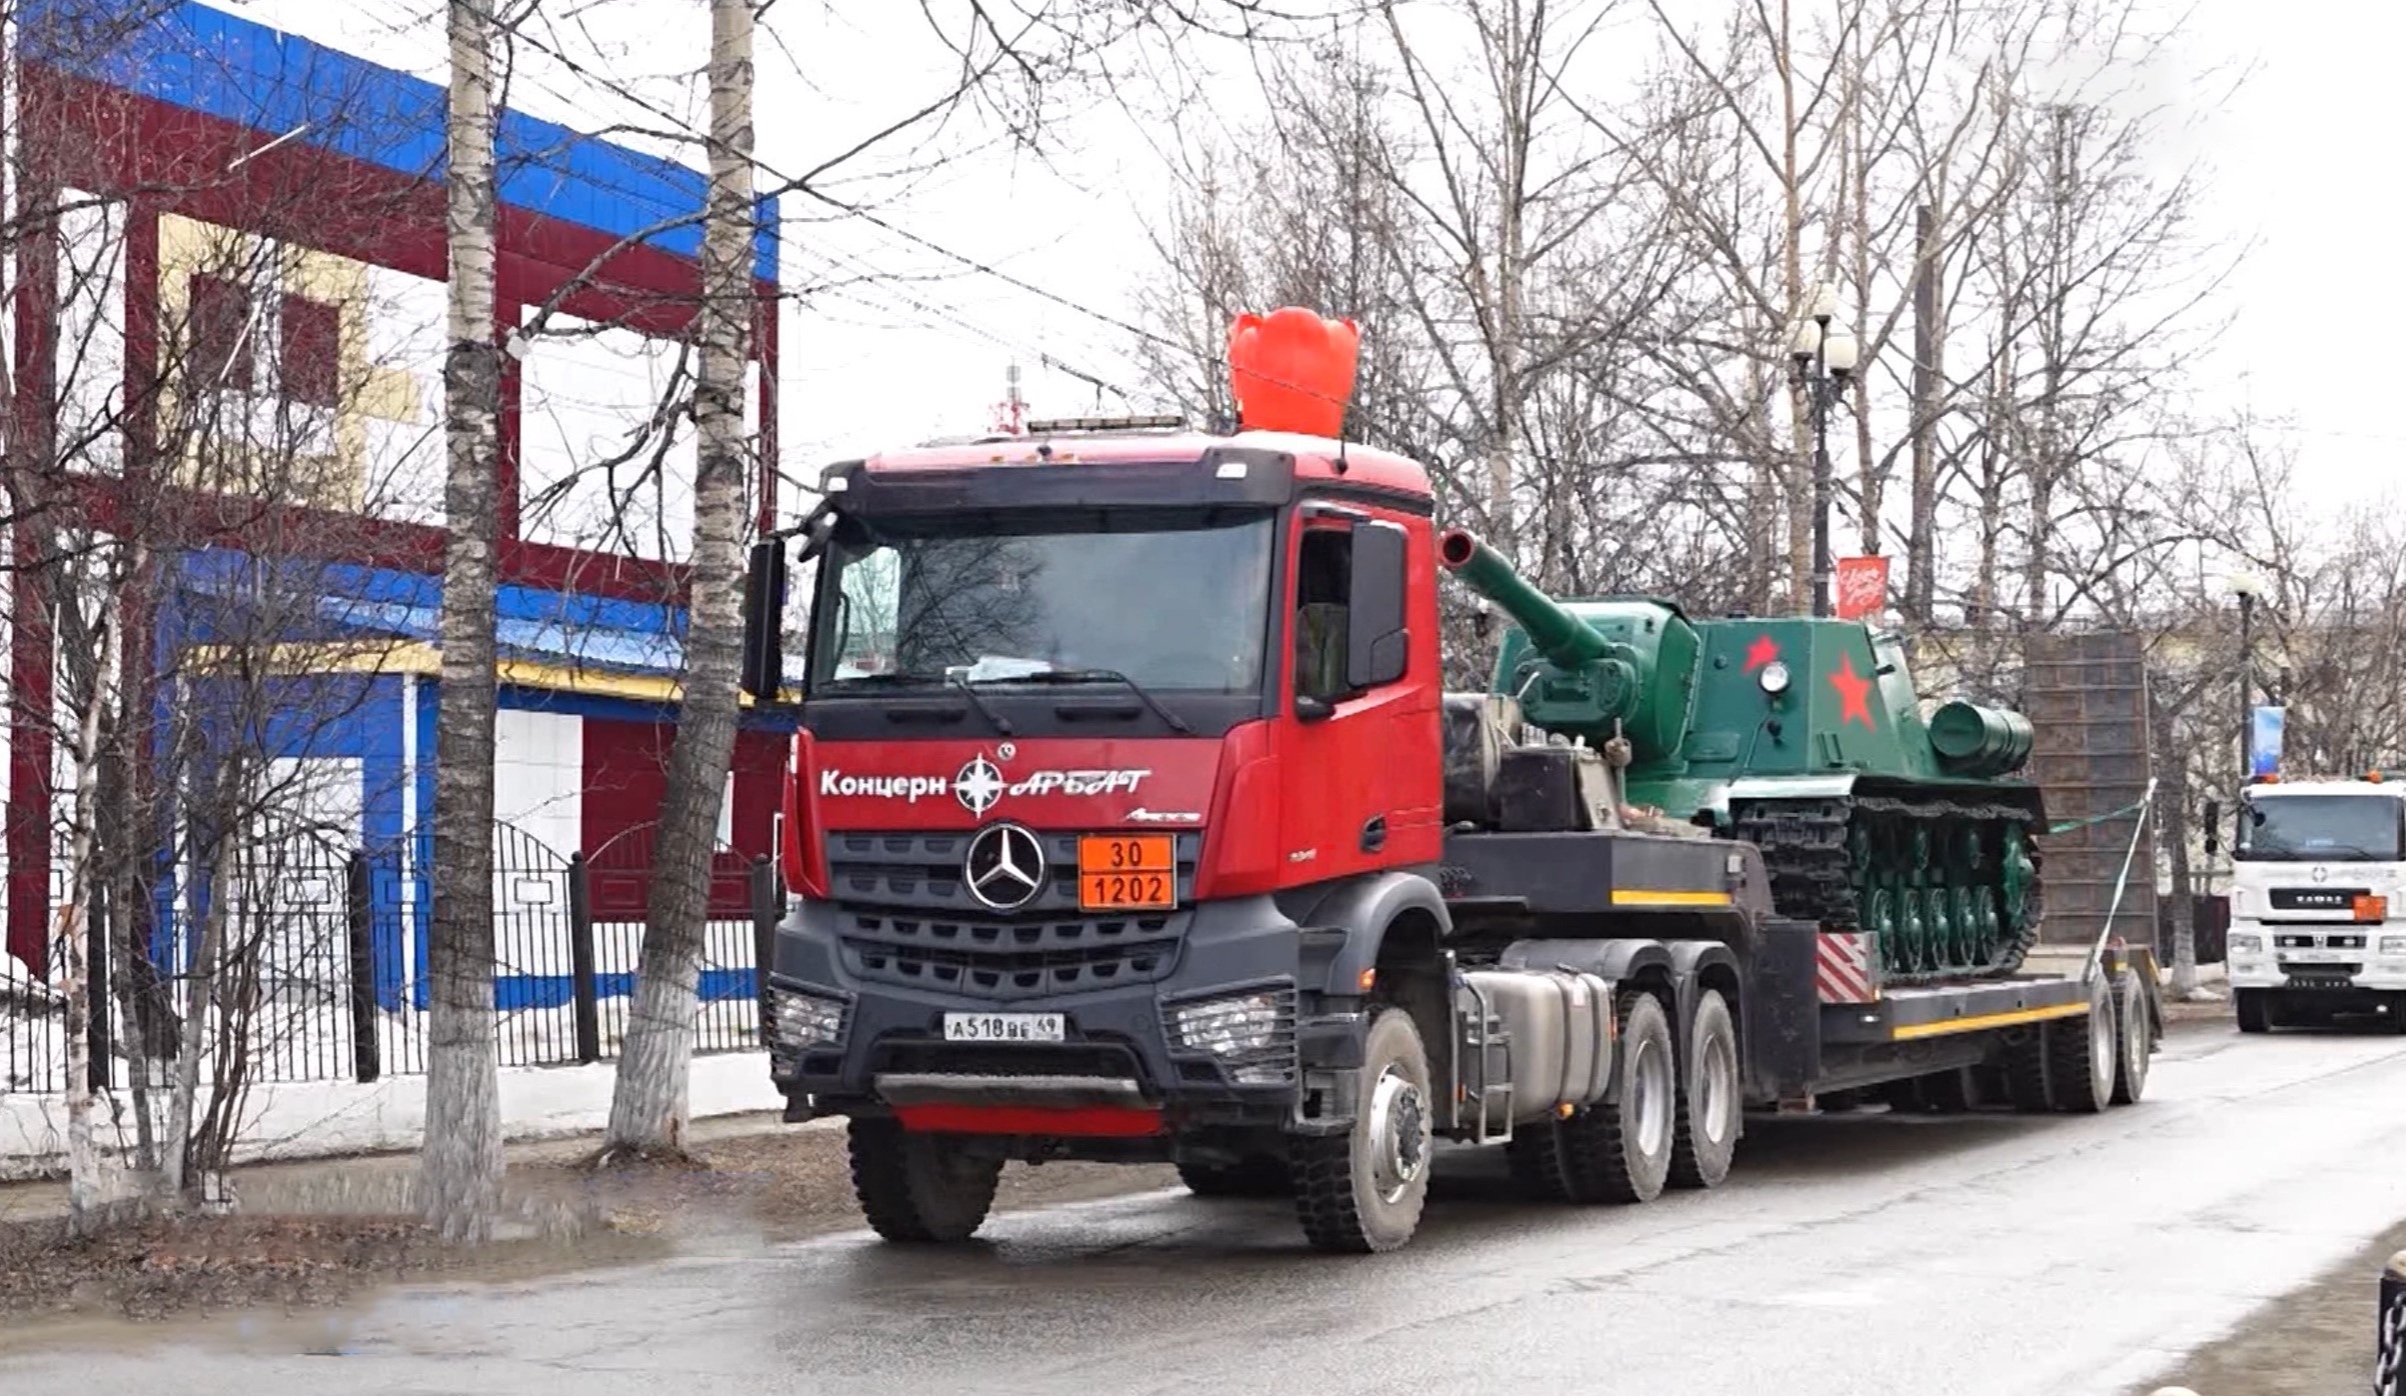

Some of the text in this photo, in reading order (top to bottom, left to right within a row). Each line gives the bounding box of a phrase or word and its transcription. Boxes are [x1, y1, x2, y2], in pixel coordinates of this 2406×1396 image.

[821, 769, 947, 804] Концерн
[1111, 841, 1142, 868] 30
[1095, 876, 1163, 904] 1202
